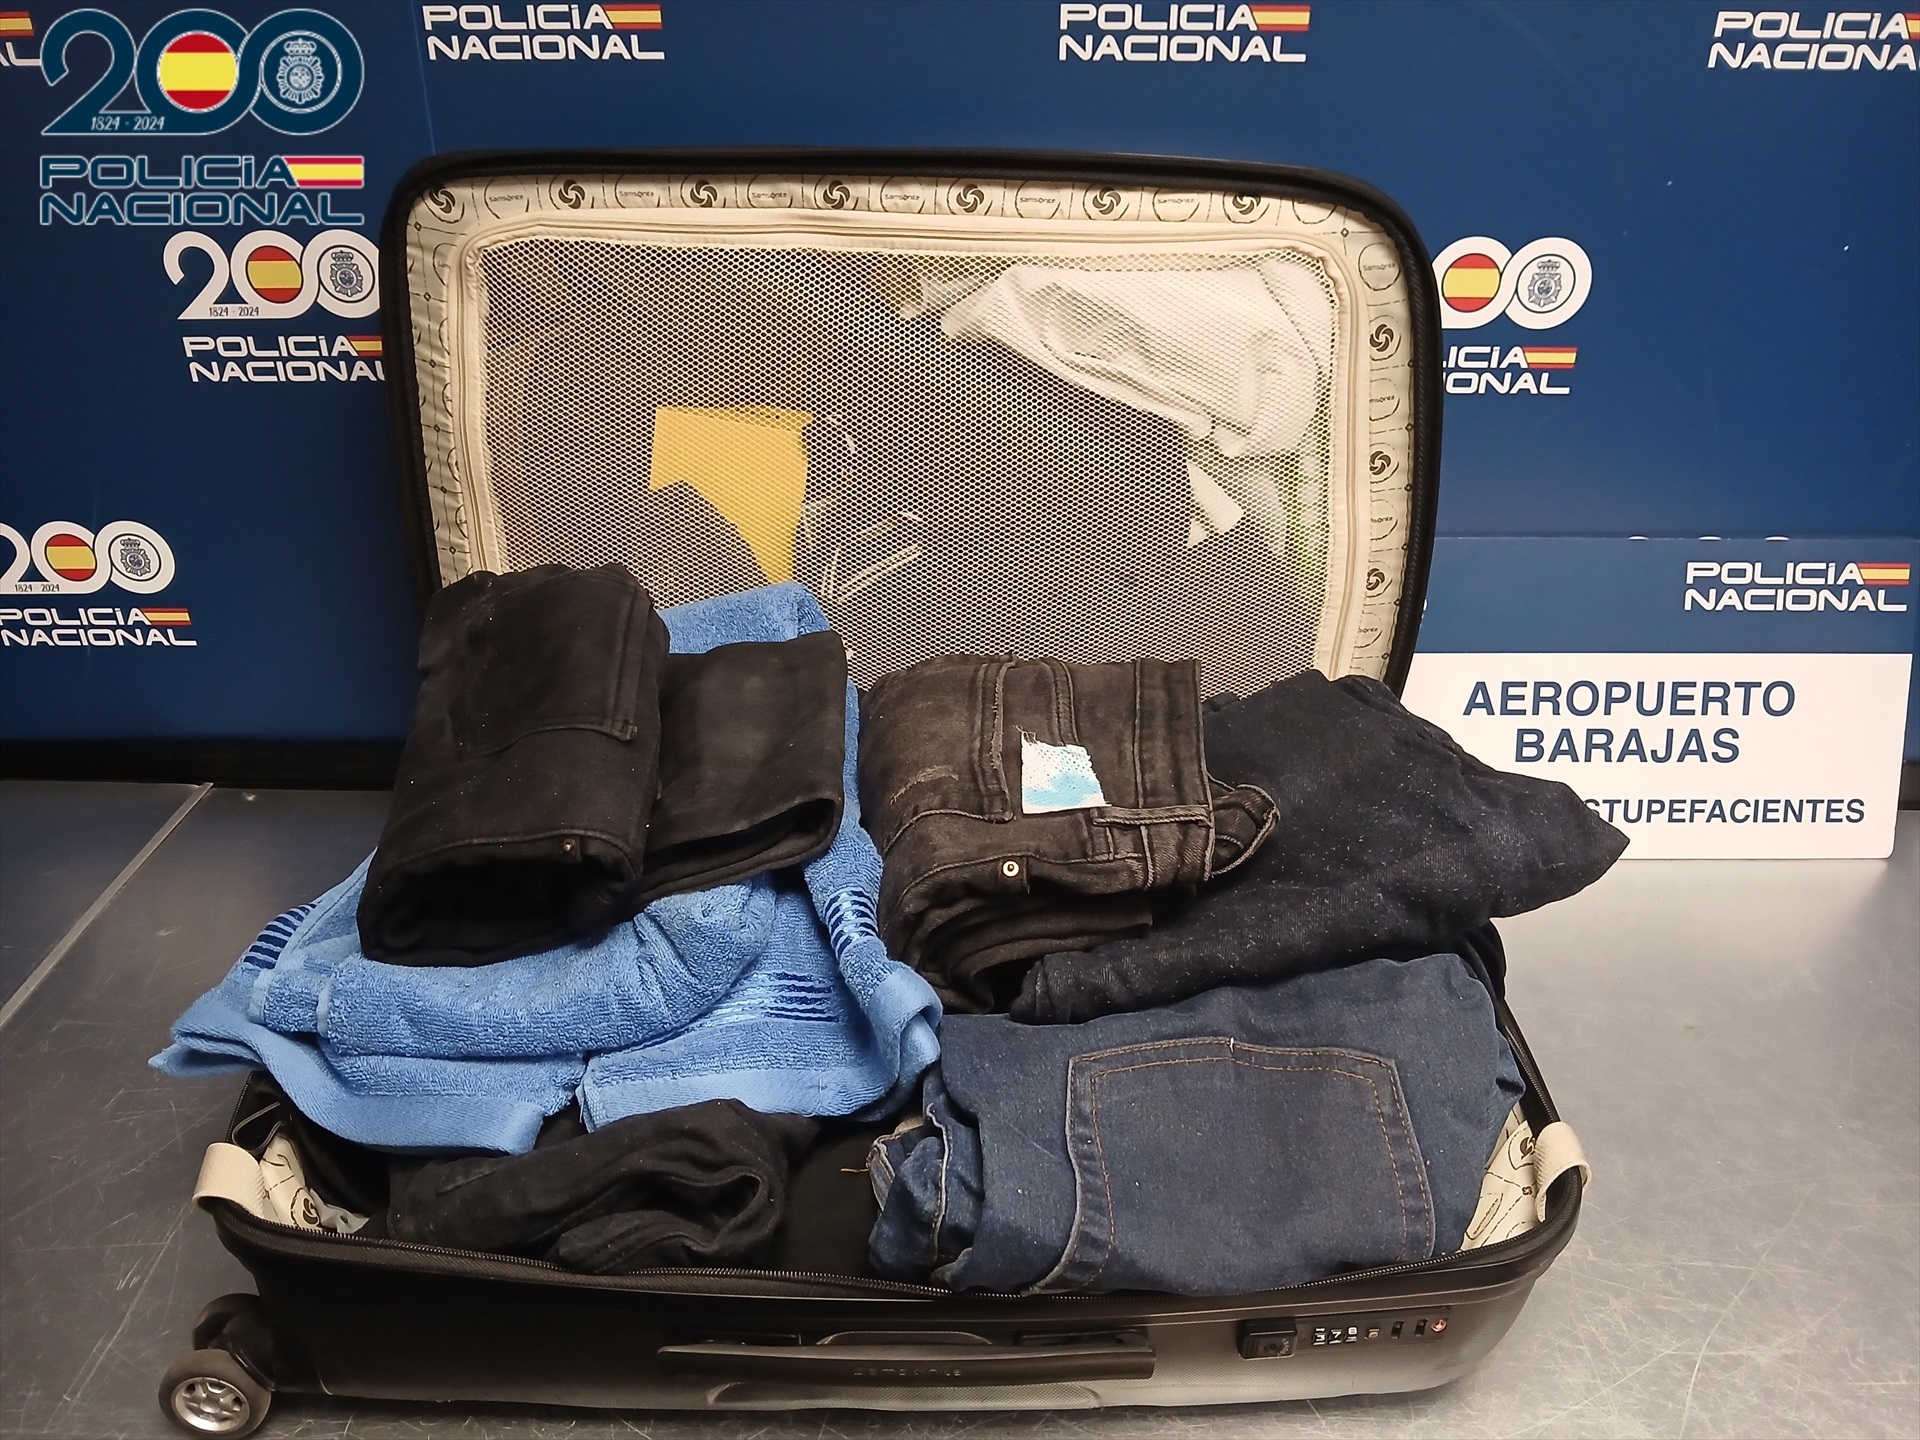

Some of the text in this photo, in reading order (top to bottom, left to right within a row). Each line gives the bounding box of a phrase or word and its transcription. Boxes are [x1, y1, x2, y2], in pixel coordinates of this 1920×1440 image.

[426, 35, 666, 60] NACIONAL
[1059, 34, 1307, 62] NACIONAL
[1707, 42, 1920, 71] NACIONA
[208, 306, 229, 317] 1824
[238, 306, 259, 317] 2024
[1684, 588, 1908, 612] NACIONAL
[1, 628, 198, 646] NACIONAL
[1462, 680, 1796, 717] AEROPUERTO
[1514, 727, 1740, 764] BARAJAS
[1583, 798, 1866, 824] STUPEFACIENTES
